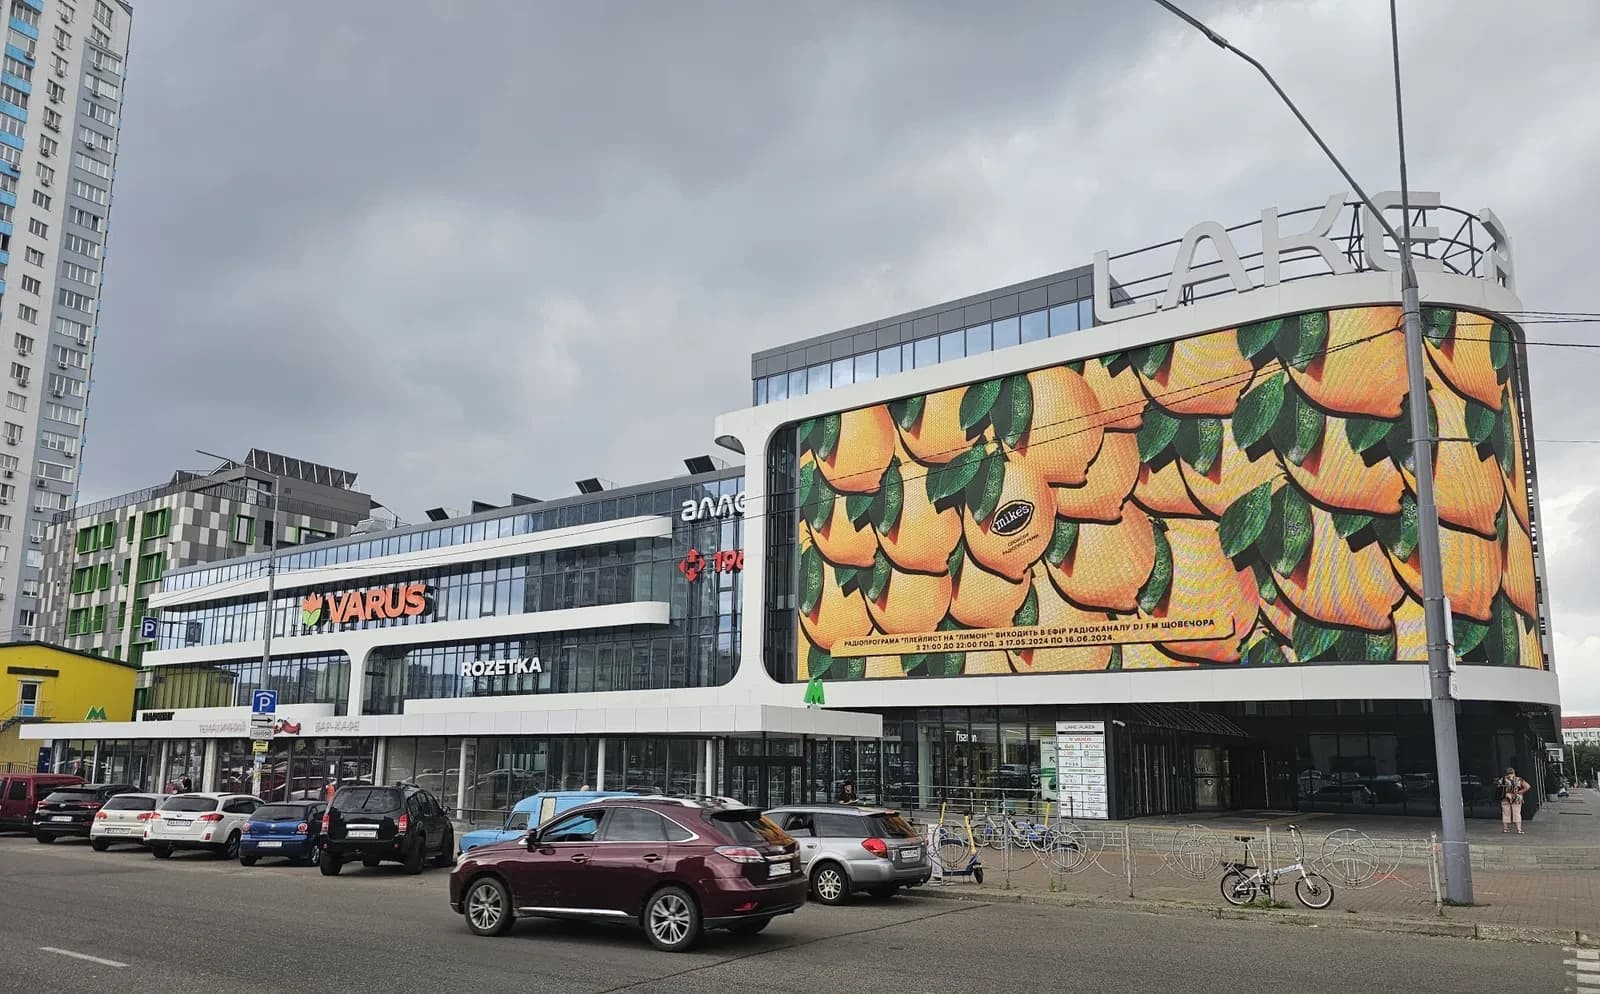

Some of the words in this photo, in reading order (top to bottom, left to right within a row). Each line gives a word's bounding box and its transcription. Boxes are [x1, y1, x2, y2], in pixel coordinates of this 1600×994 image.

[1093, 191, 1444, 323] LAKE
[995, 504, 1030, 530] mike's
[327, 583, 426, 624] VARUS
[143, 623, 155, 637] P
[844, 637, 899, 647] РАДІОПРОГРАМА
[995, 629, 1038, 638] ВИХОДИТЬ
[1069, 624, 1131, 634] РАДІОКАНАЛУ
[1133, 623, 1143, 631] DJ
[1161, 619, 1215, 629] ЩОВЕЧОРА
[943, 642, 954, 650] ДО
[956, 641, 977, 649] 22:00
[979, 640, 997, 648] ГОД.
[1006, 637, 1048, 646] 17.05.2024
[461, 656, 542, 677] ROZETKA
[259, 697, 271, 711] P
